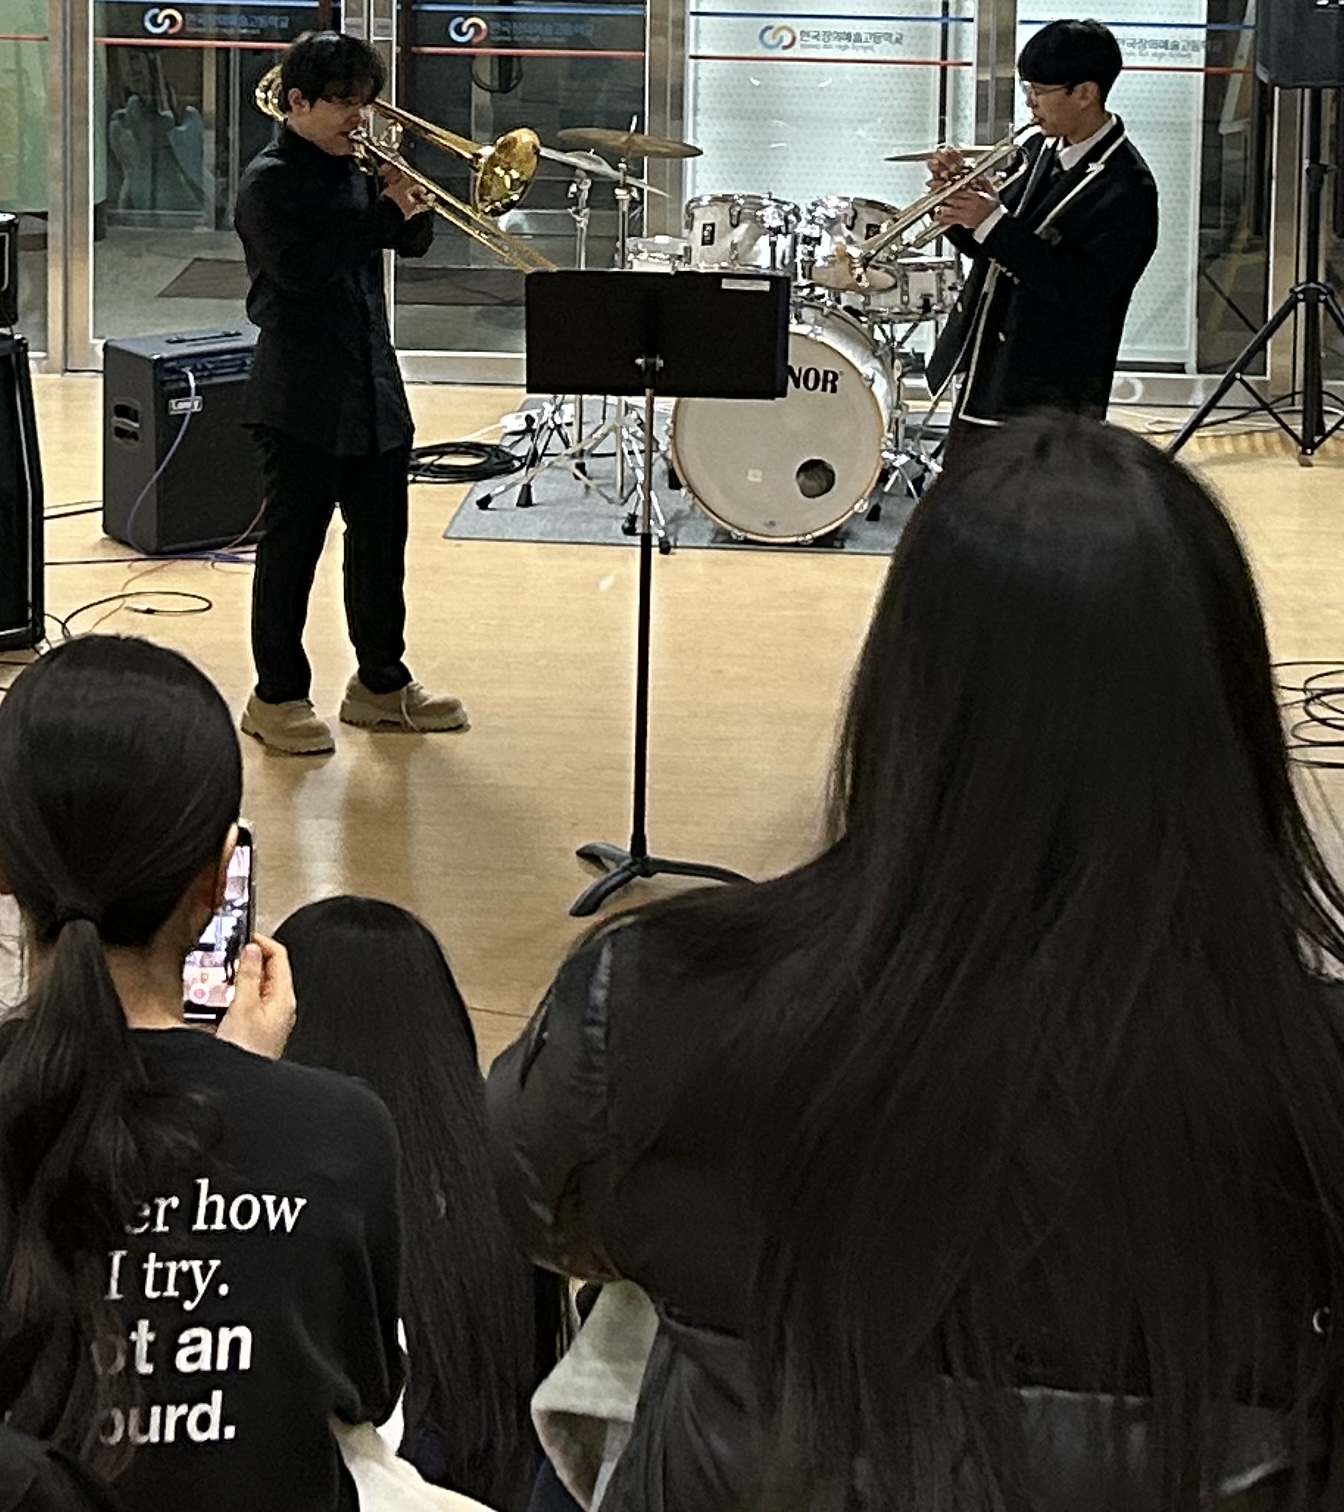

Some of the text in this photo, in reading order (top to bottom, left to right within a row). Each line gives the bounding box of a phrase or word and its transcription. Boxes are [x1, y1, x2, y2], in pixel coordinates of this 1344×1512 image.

[787, 365, 839, 394] NOR
[191, 1178, 307, 1234] how
[104, 1250, 229, 1311] I try.
[175, 1324, 253, 1373] an
